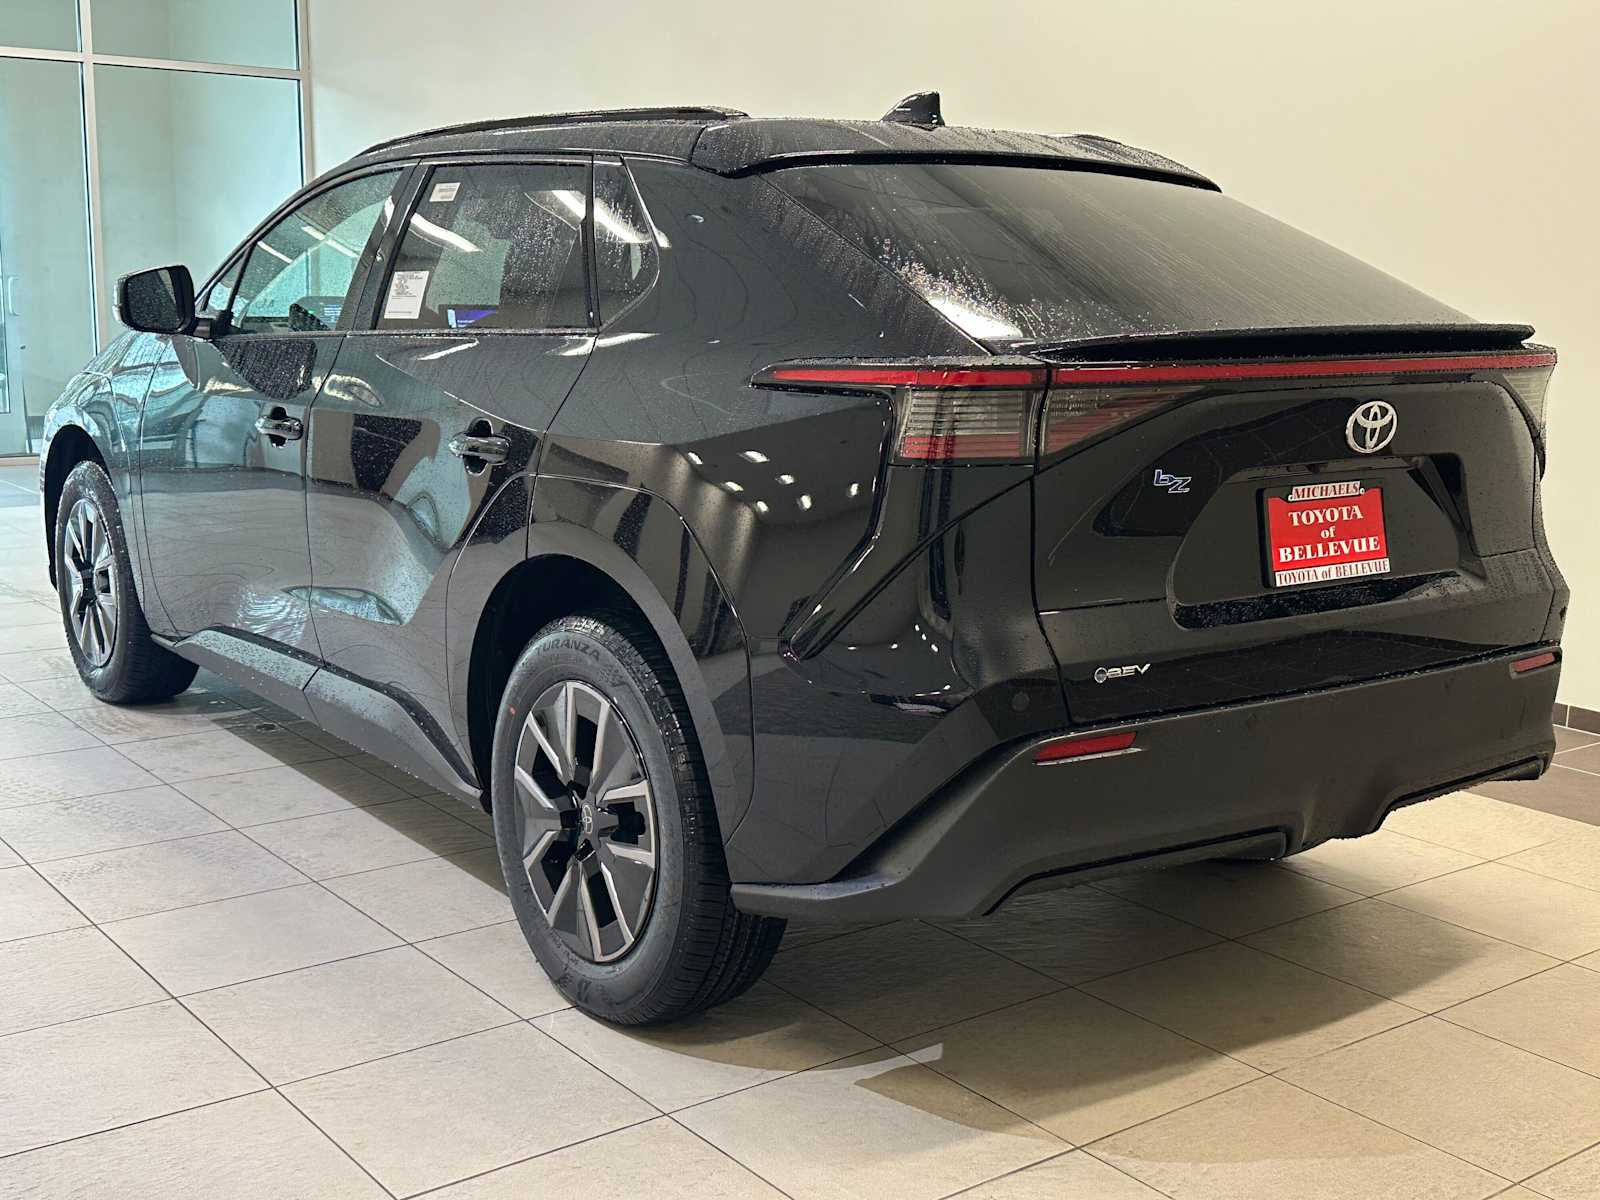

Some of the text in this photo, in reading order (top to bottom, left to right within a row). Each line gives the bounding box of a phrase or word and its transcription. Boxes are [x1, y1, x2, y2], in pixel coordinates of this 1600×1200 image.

[1293, 482, 1360, 499] MICHAELS
[1288, 505, 1364, 526] TOYOTA
[1320, 526, 1336, 539] of
[1278, 536, 1381, 563] BELLEVUE
[1277, 560, 1389, 585] TOYOTA of BELLEVUE
[537, 638, 601, 661] TURANZA
